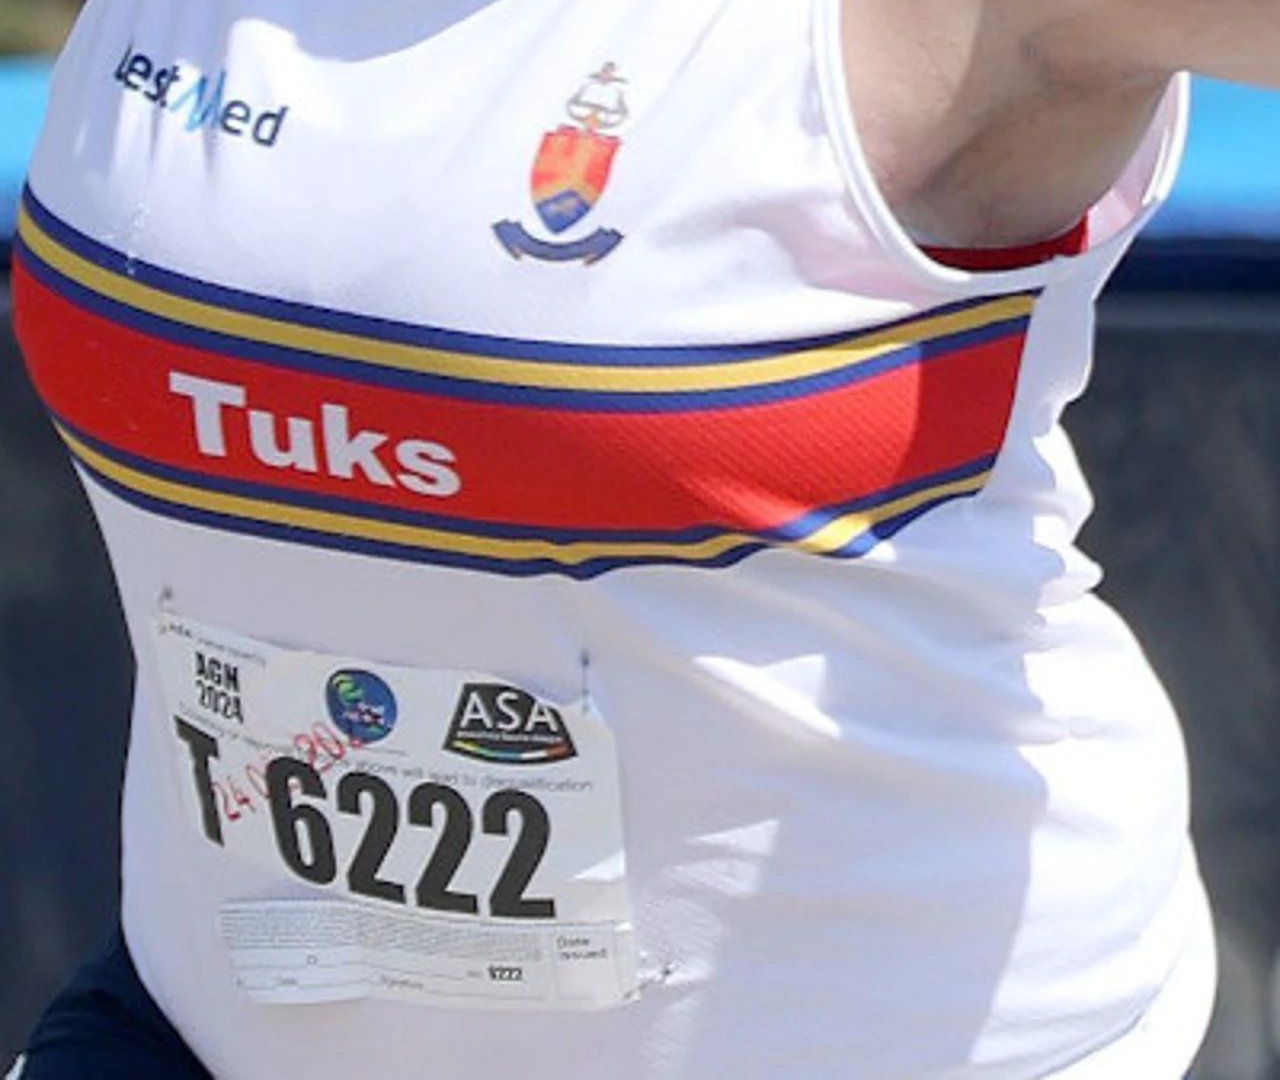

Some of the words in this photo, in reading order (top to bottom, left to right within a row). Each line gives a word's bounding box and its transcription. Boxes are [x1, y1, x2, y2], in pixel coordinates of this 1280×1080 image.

[168, 370, 462, 497] Tuks
[194, 679, 245, 725] 2024
[459, 690, 560, 732] ASA
[173, 713, 225, 847] T
[264, 755, 557, 919] 6222
